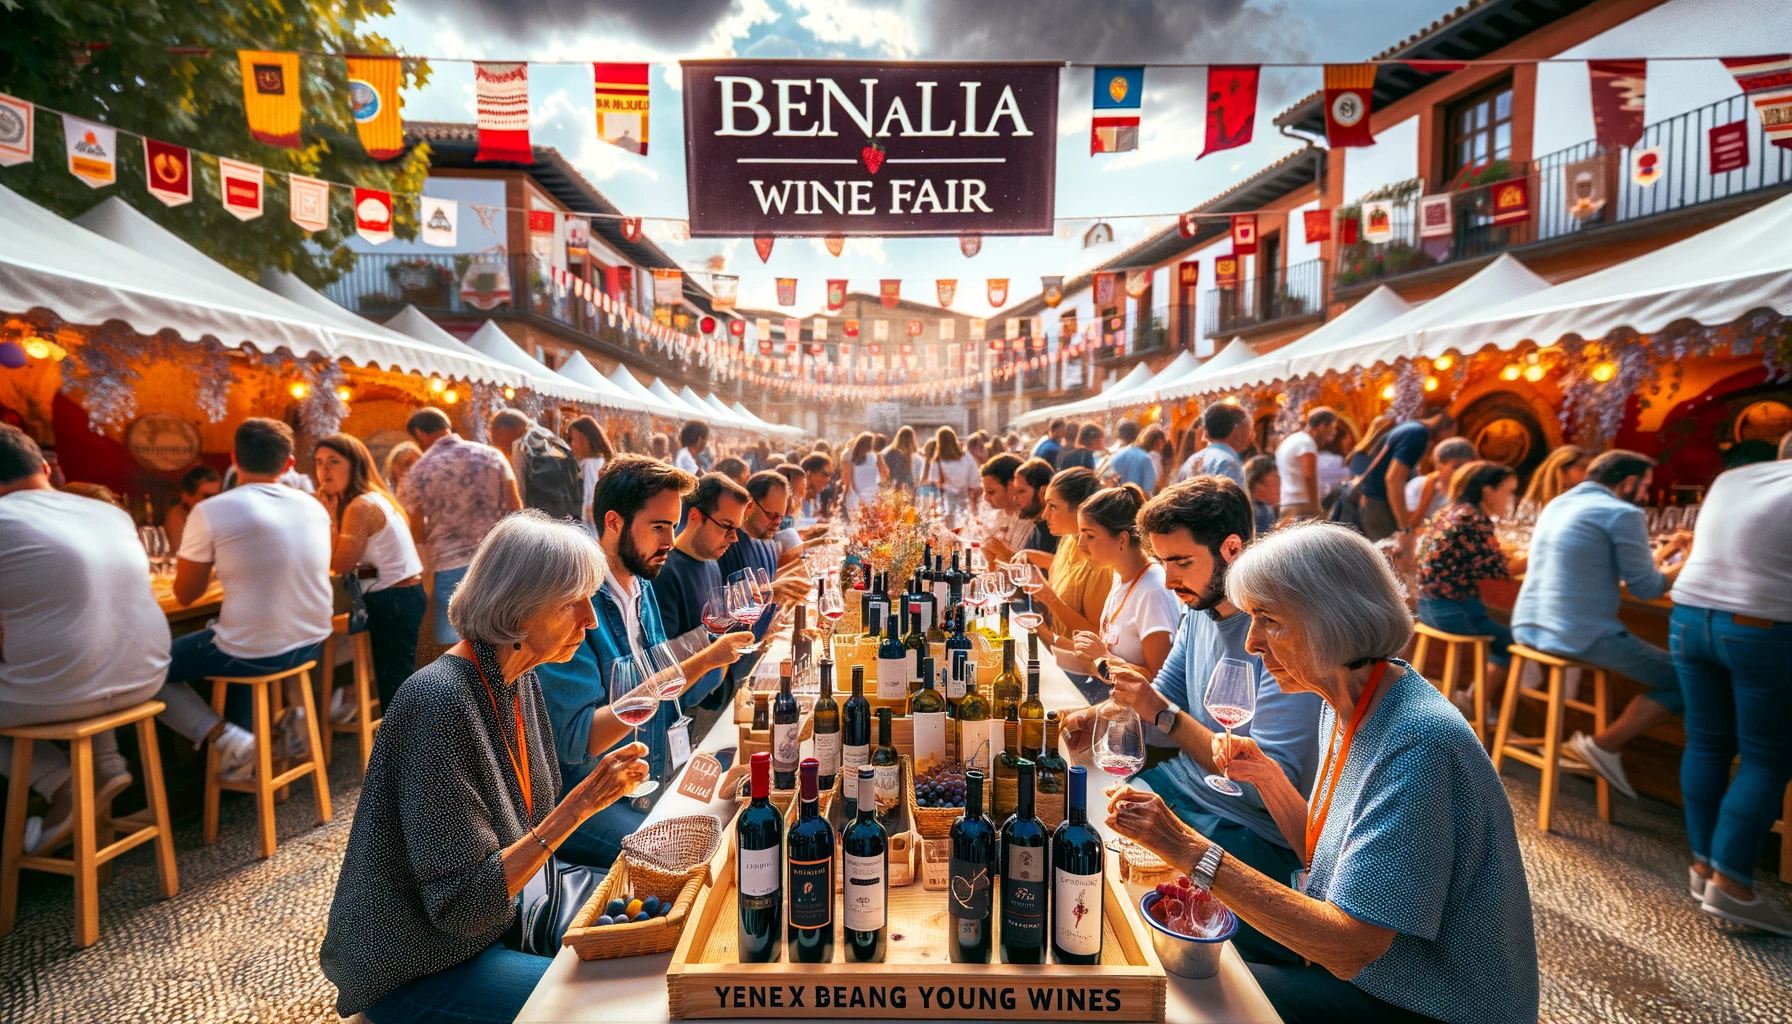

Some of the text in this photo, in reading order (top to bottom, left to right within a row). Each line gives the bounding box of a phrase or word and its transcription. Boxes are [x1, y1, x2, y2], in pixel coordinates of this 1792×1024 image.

[714, 75, 1034, 138] BENALIA
[748, 178, 994, 216] WINE FAIR
[814, 984, 907, 1010] BEANG
[917, 986, 1017, 1012] YOUNG
[1026, 987, 1123, 1014] WINES
